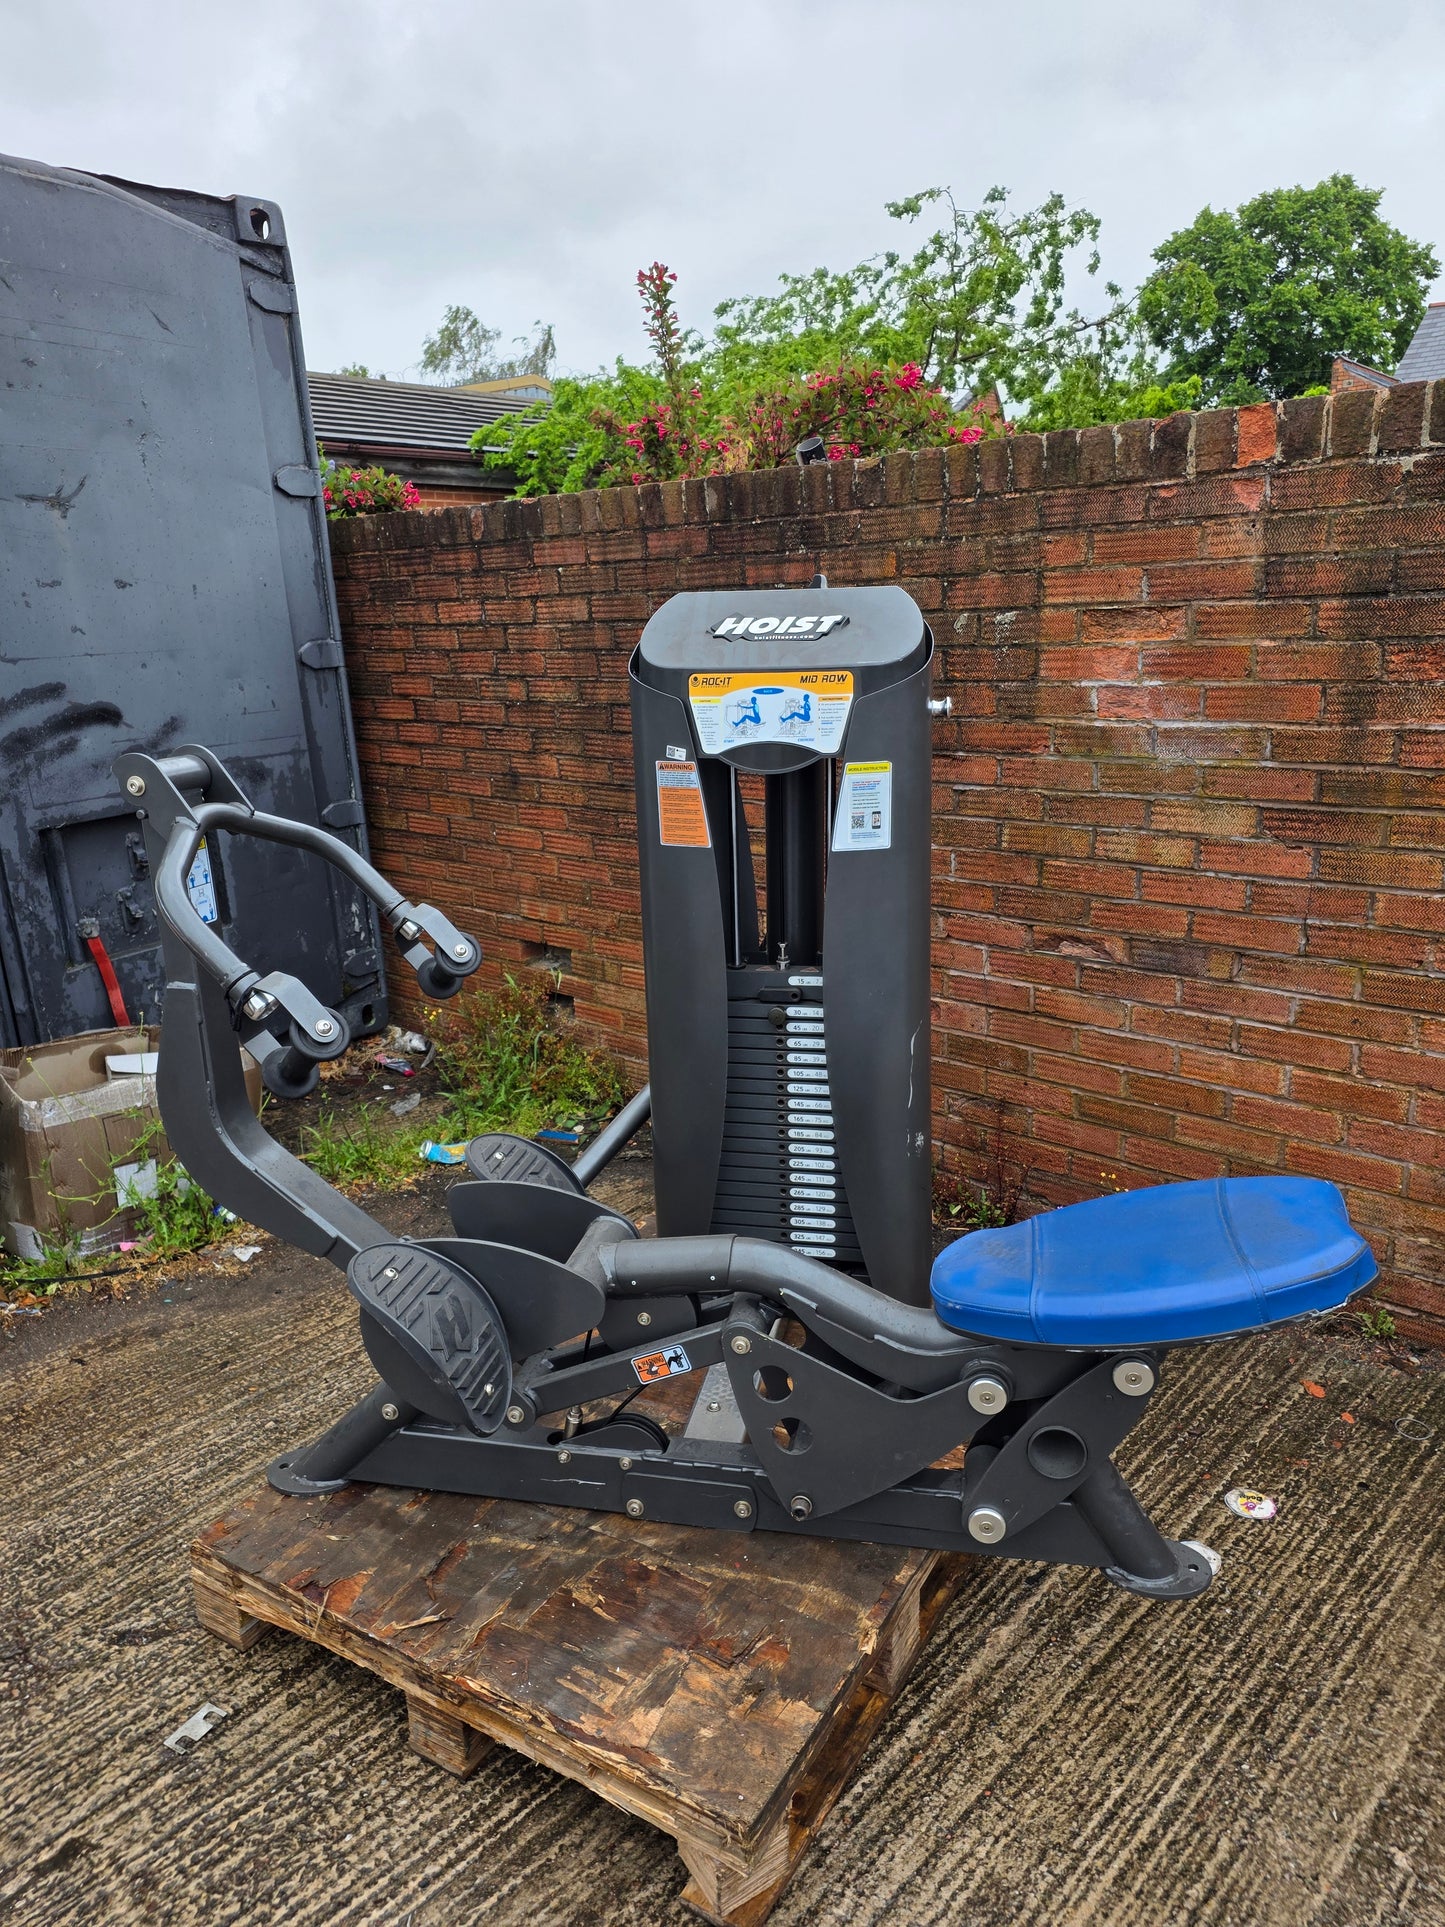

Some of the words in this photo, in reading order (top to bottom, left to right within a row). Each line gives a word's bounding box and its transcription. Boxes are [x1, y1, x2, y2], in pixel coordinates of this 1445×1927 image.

[714, 615, 843, 635] HOIST
[800, 675, 818, 683] MID
[821, 674, 847, 683] ROW
